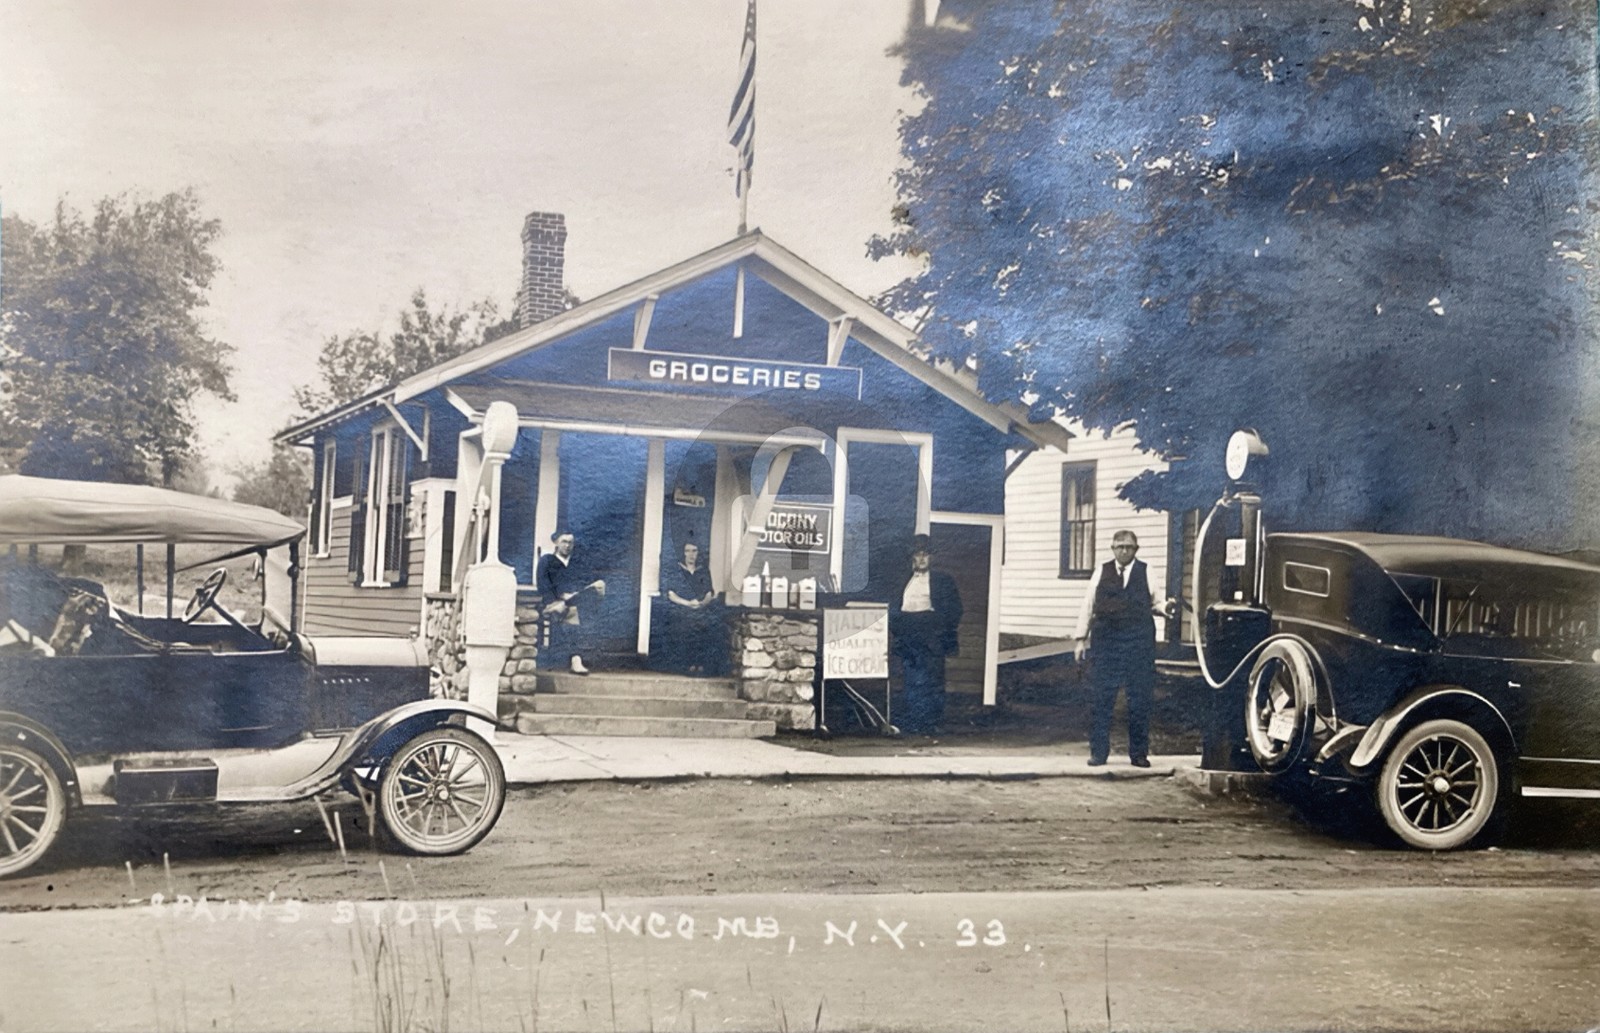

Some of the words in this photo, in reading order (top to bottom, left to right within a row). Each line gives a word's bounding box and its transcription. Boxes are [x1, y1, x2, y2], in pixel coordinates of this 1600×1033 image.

[649, 359, 821, 390] GROCERIES
[767, 511, 817, 530] OCONY
[760, 530, 792, 544] OTOR
[795, 532, 824, 546] OILS
[828, 638, 884, 650] QUALITY
[827, 654, 845, 675] ICE
